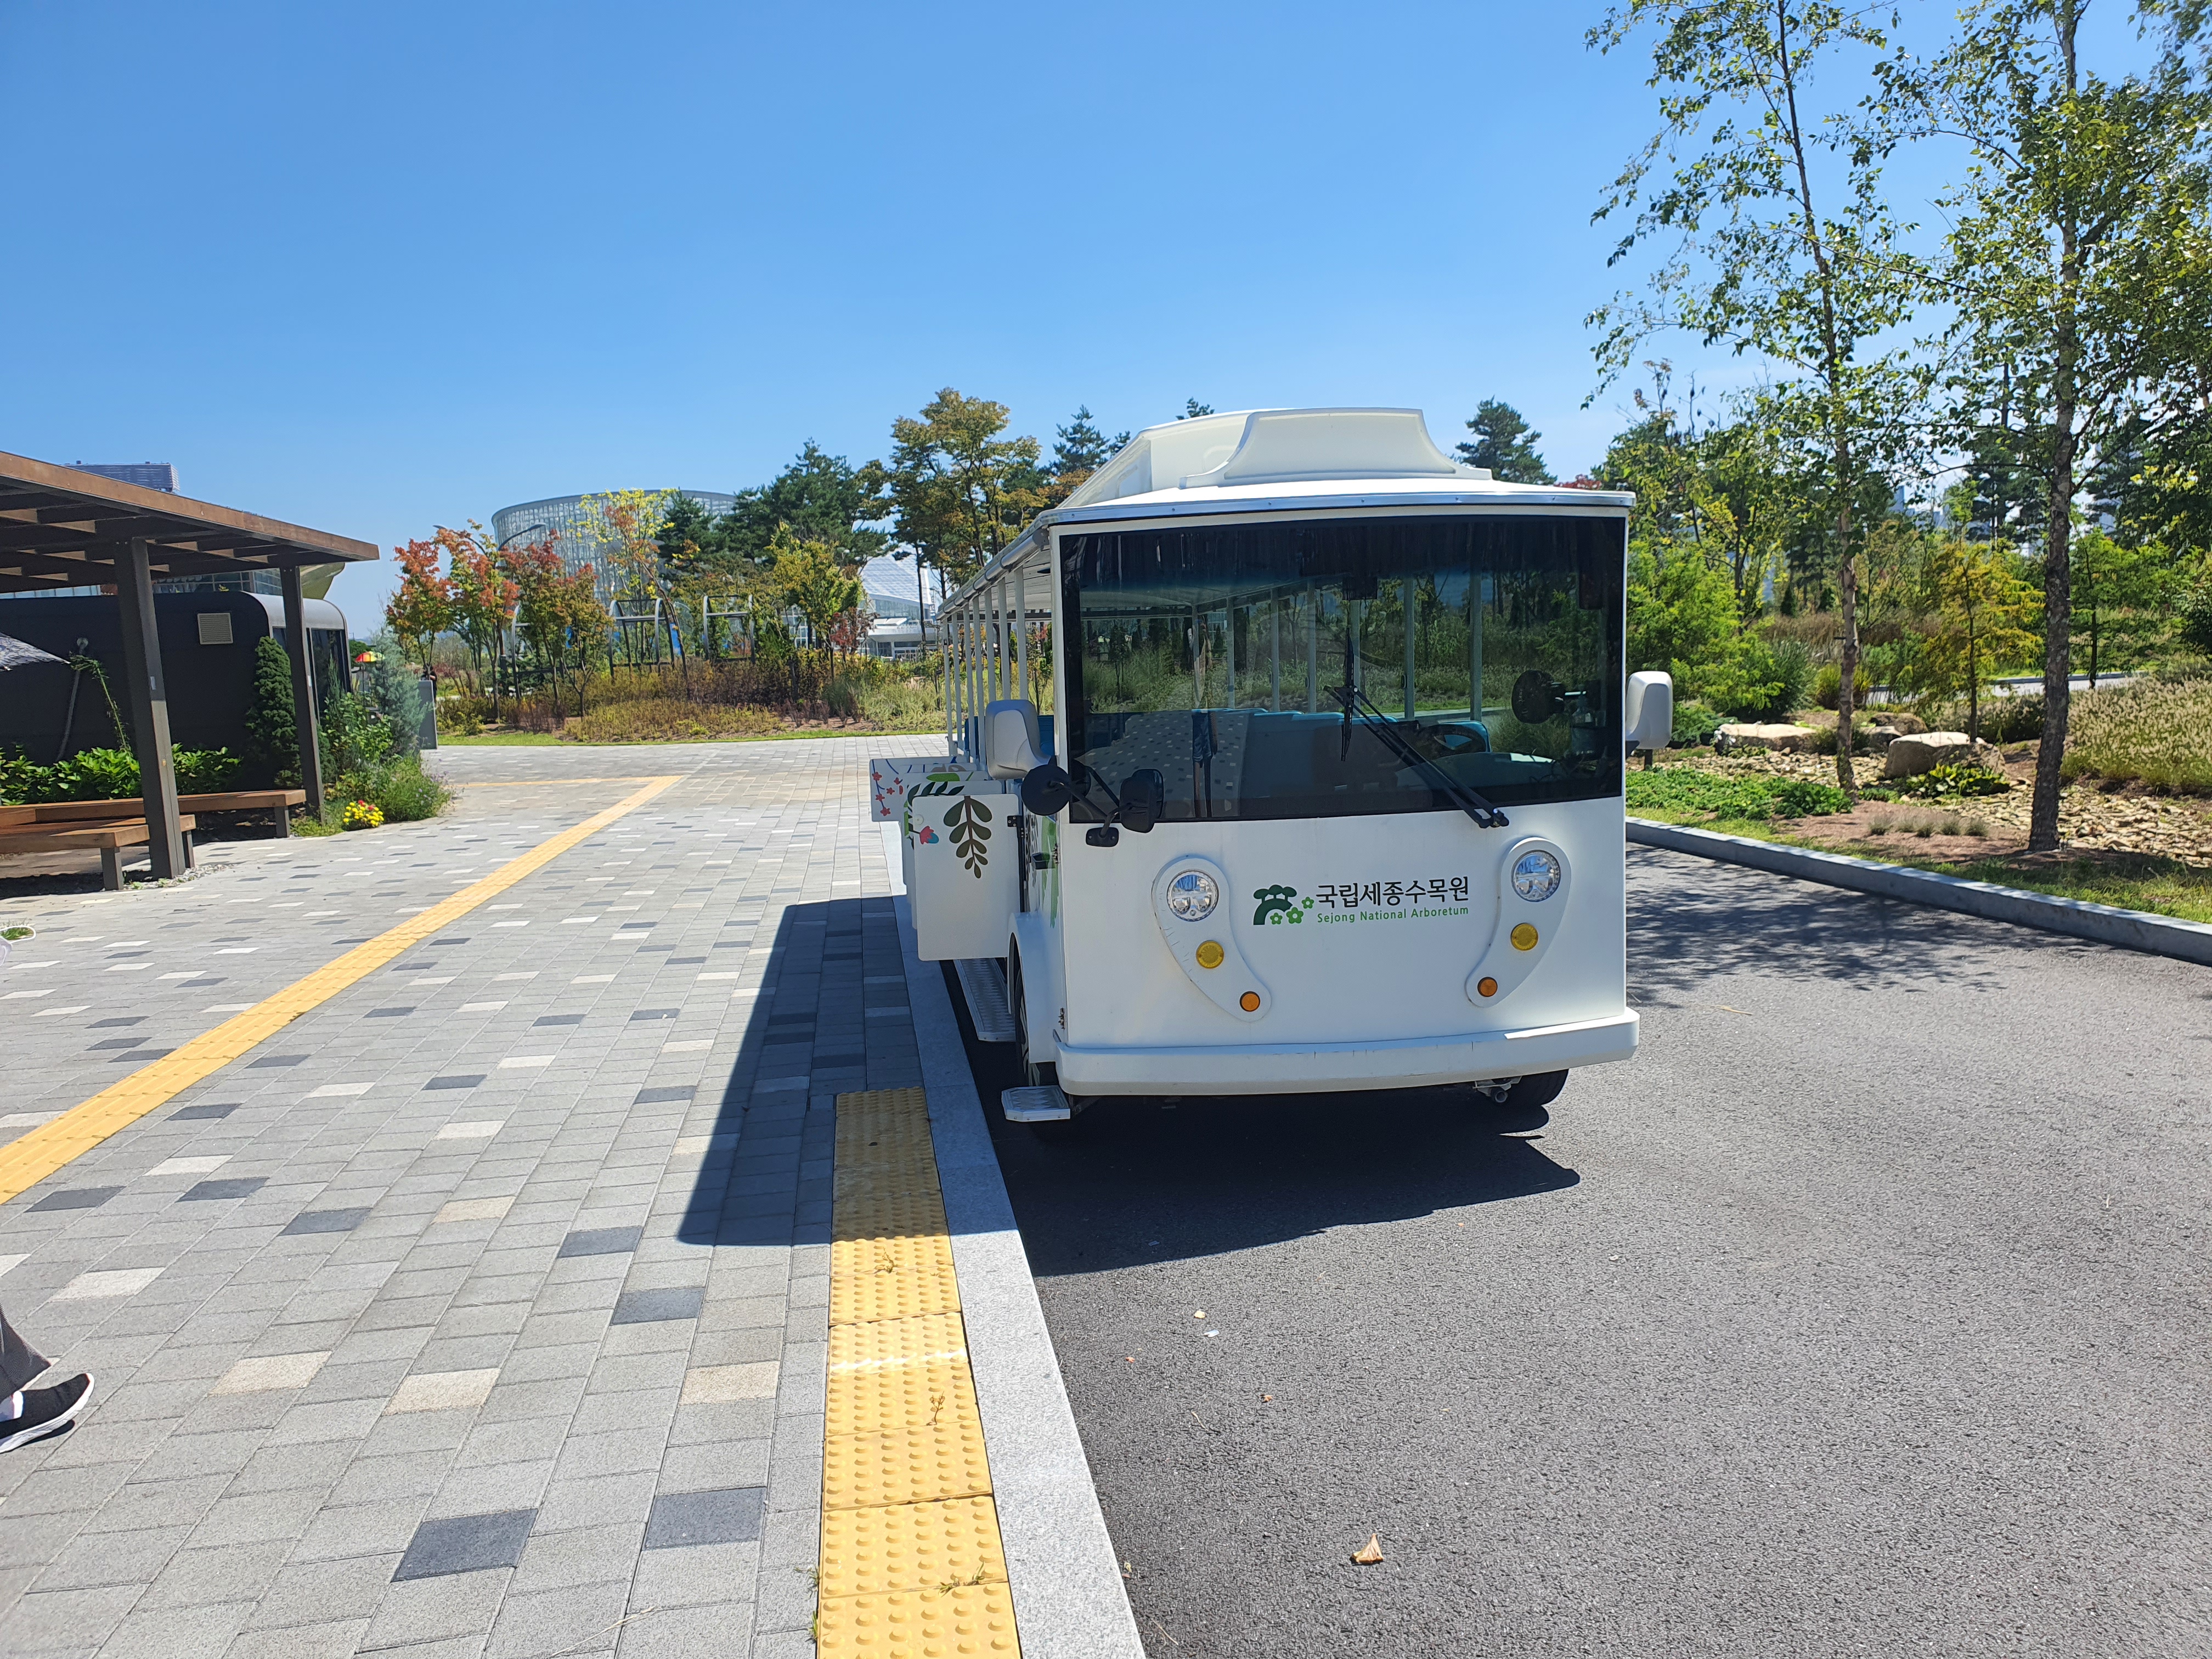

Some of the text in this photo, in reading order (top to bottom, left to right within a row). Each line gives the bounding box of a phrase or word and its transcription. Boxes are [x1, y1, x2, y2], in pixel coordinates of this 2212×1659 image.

[1316, 876, 1469, 909] 국립세종수목원
[1317, 906, 1469, 923] Sejong National Arboretum
